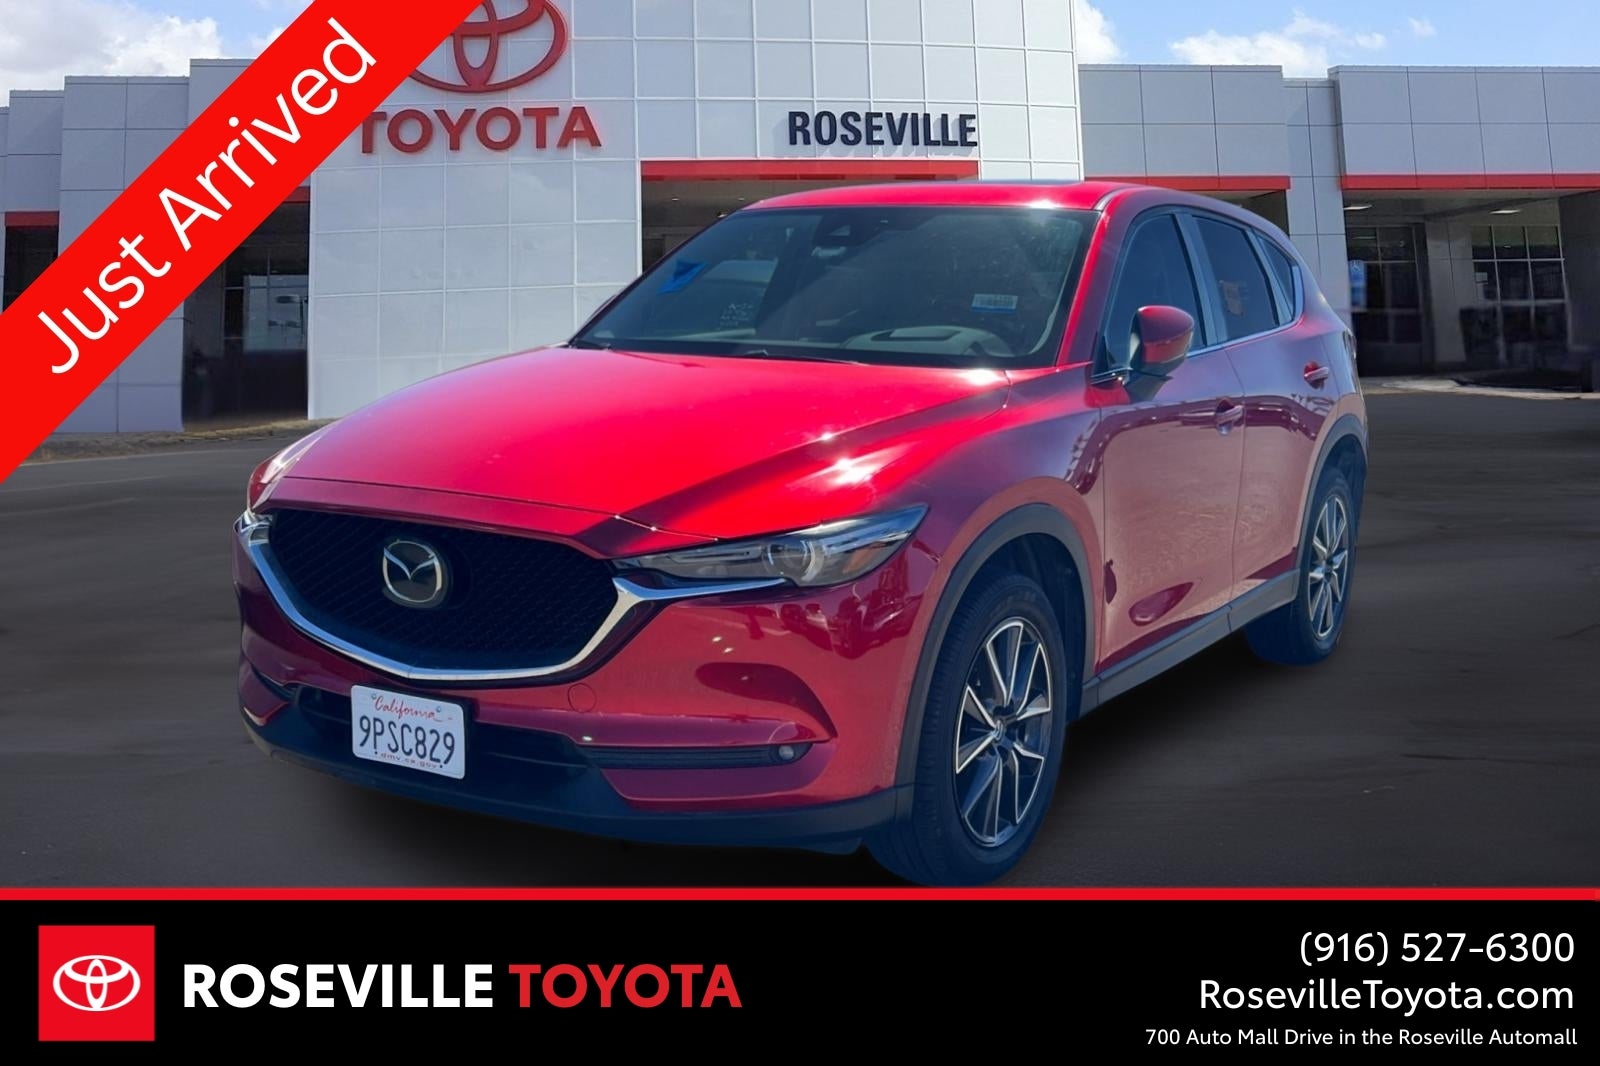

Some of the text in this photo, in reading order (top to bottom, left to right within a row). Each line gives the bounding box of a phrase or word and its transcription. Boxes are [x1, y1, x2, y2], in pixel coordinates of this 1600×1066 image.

[361, 106, 602, 154] TOYOTA
[788, 110, 978, 147] ROSEVILLE
[374, 695, 436, 720] California
[359, 715, 456, 765] 9PSC829
